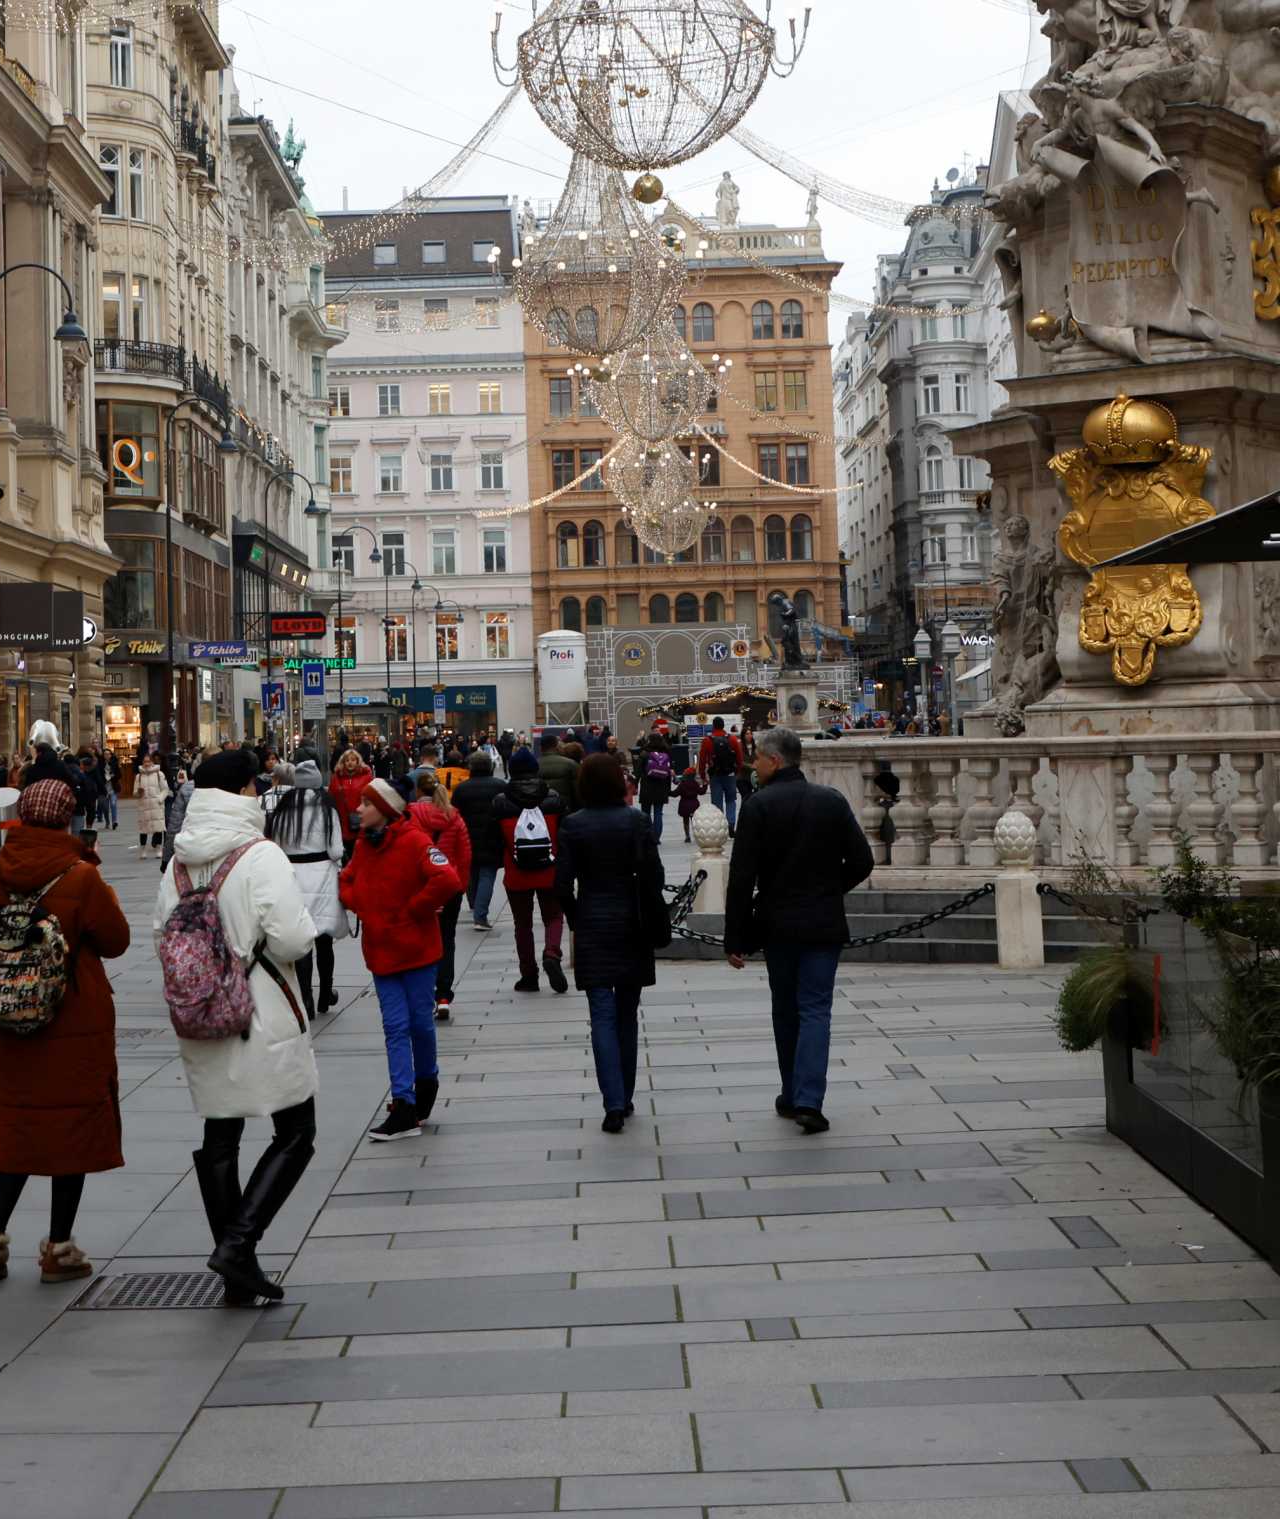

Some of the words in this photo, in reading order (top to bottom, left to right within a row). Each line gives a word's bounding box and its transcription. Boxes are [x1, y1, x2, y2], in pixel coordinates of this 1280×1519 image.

[113, 438, 144, 485] Q
[274, 621, 321, 631] LLOYD
[128, 640, 166, 654] Tchibo
[207, 645, 244, 655] Tchibo
[550, 650, 574, 660] Profi
